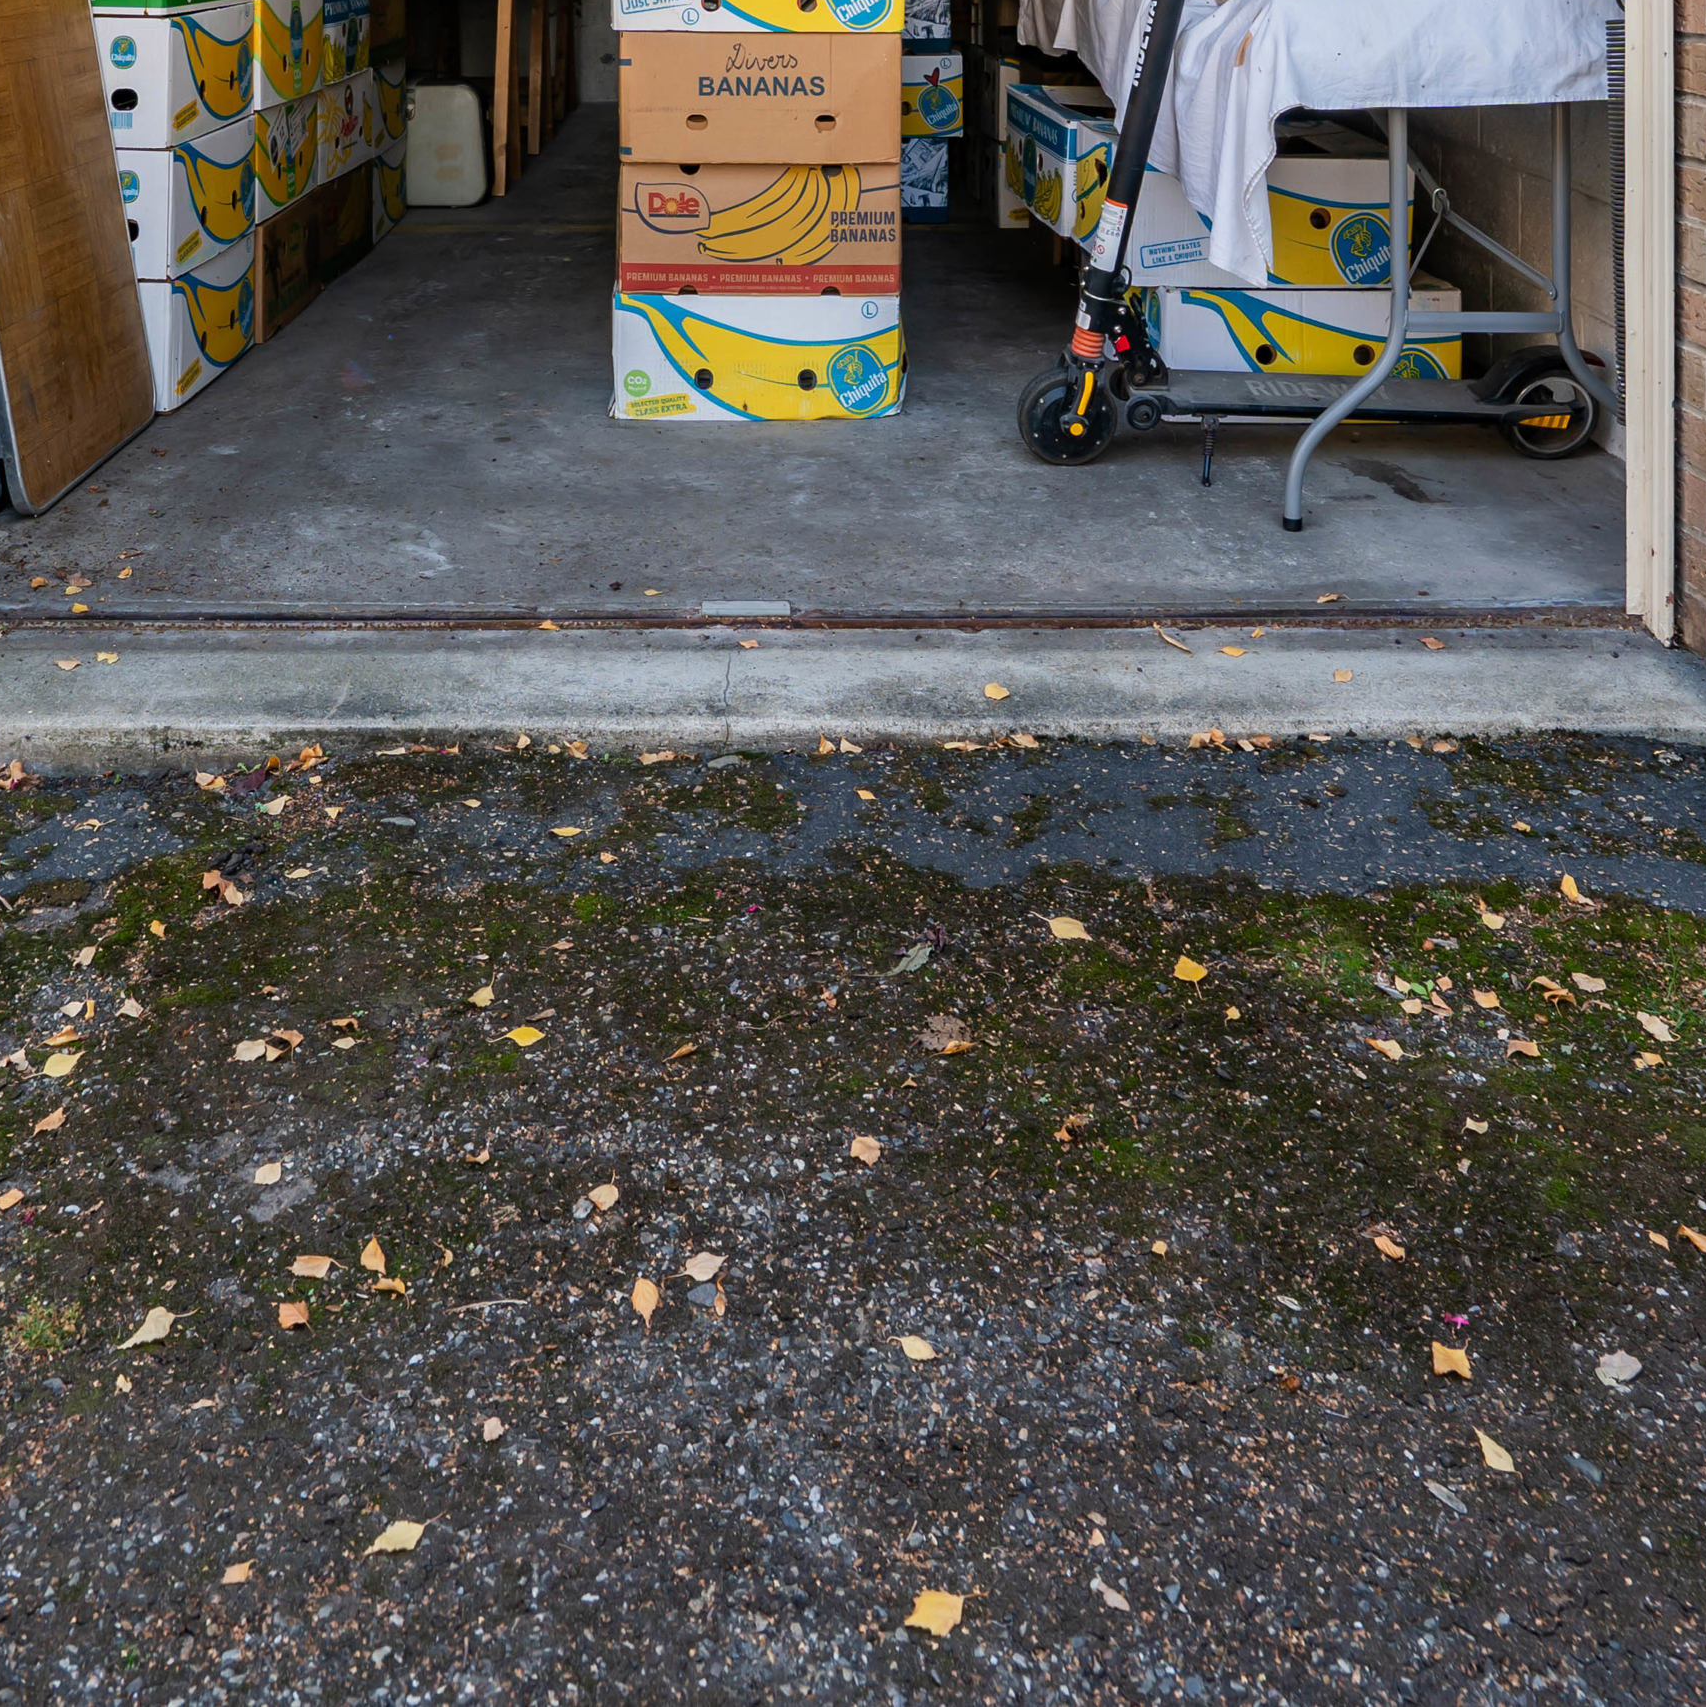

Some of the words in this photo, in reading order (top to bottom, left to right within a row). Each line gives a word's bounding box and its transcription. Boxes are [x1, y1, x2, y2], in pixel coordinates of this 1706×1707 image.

[698, 76, 826, 96] BANANAS
[927, 102, 959, 126] Chiquita
[648, 192, 700, 215] Dole
[830, 211, 895, 226] PREMIUM
[830, 227, 896, 243] BANANAS
[1148, 245, 1176, 256] NOTHING
[1177, 241, 1201, 252] TASTES
[1152, 255, 1166, 264] LIKE
[1174, 250, 1203, 260] CHIQUITA
[1345, 245, 1391, 282] Chiquit
[626, 272, 666, 281] PREMIUM
[668, 273, 708, 282] BANANAS
[719, 273, 759, 283] PREMIUM
[762, 274, 802, 283] BANANAS
[812, 274, 852, 283] PREMIUM
[854, 273, 894, 283] BANANAS
[839, 369, 888, 408] Chiquita
[660, 395, 686, 405] QUALITY
[634, 406, 660, 417] CLASS
[660, 402, 688, 415] EXTRA
